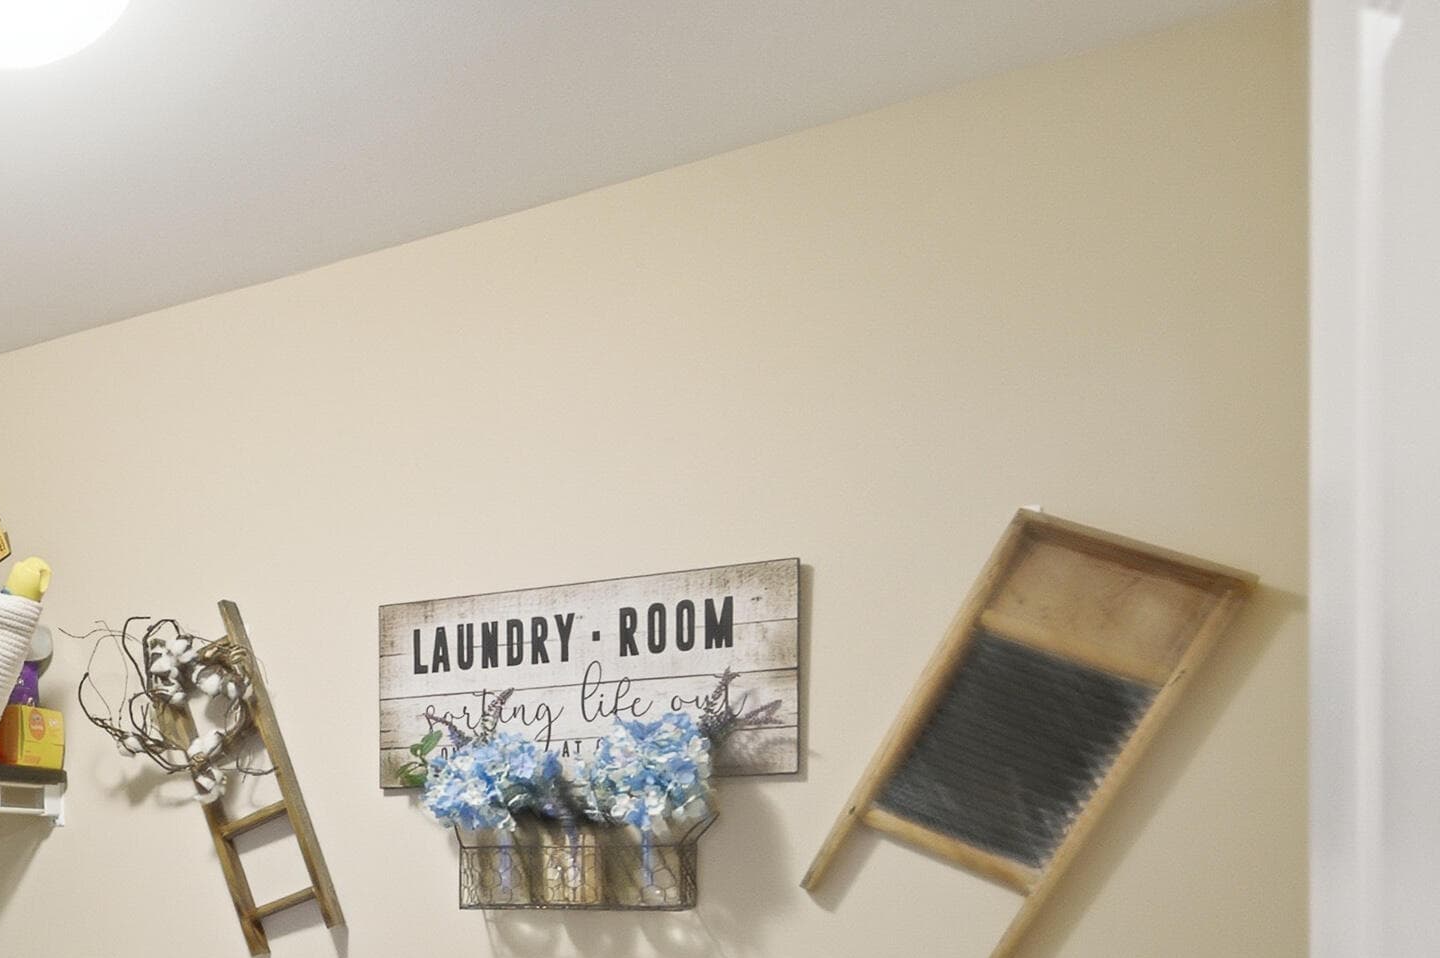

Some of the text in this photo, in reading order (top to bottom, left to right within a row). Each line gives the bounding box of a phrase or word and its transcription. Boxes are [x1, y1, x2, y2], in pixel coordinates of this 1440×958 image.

[413, 596, 735, 675] LAUNDRY ROOM
[581, 660, 655, 723] life
